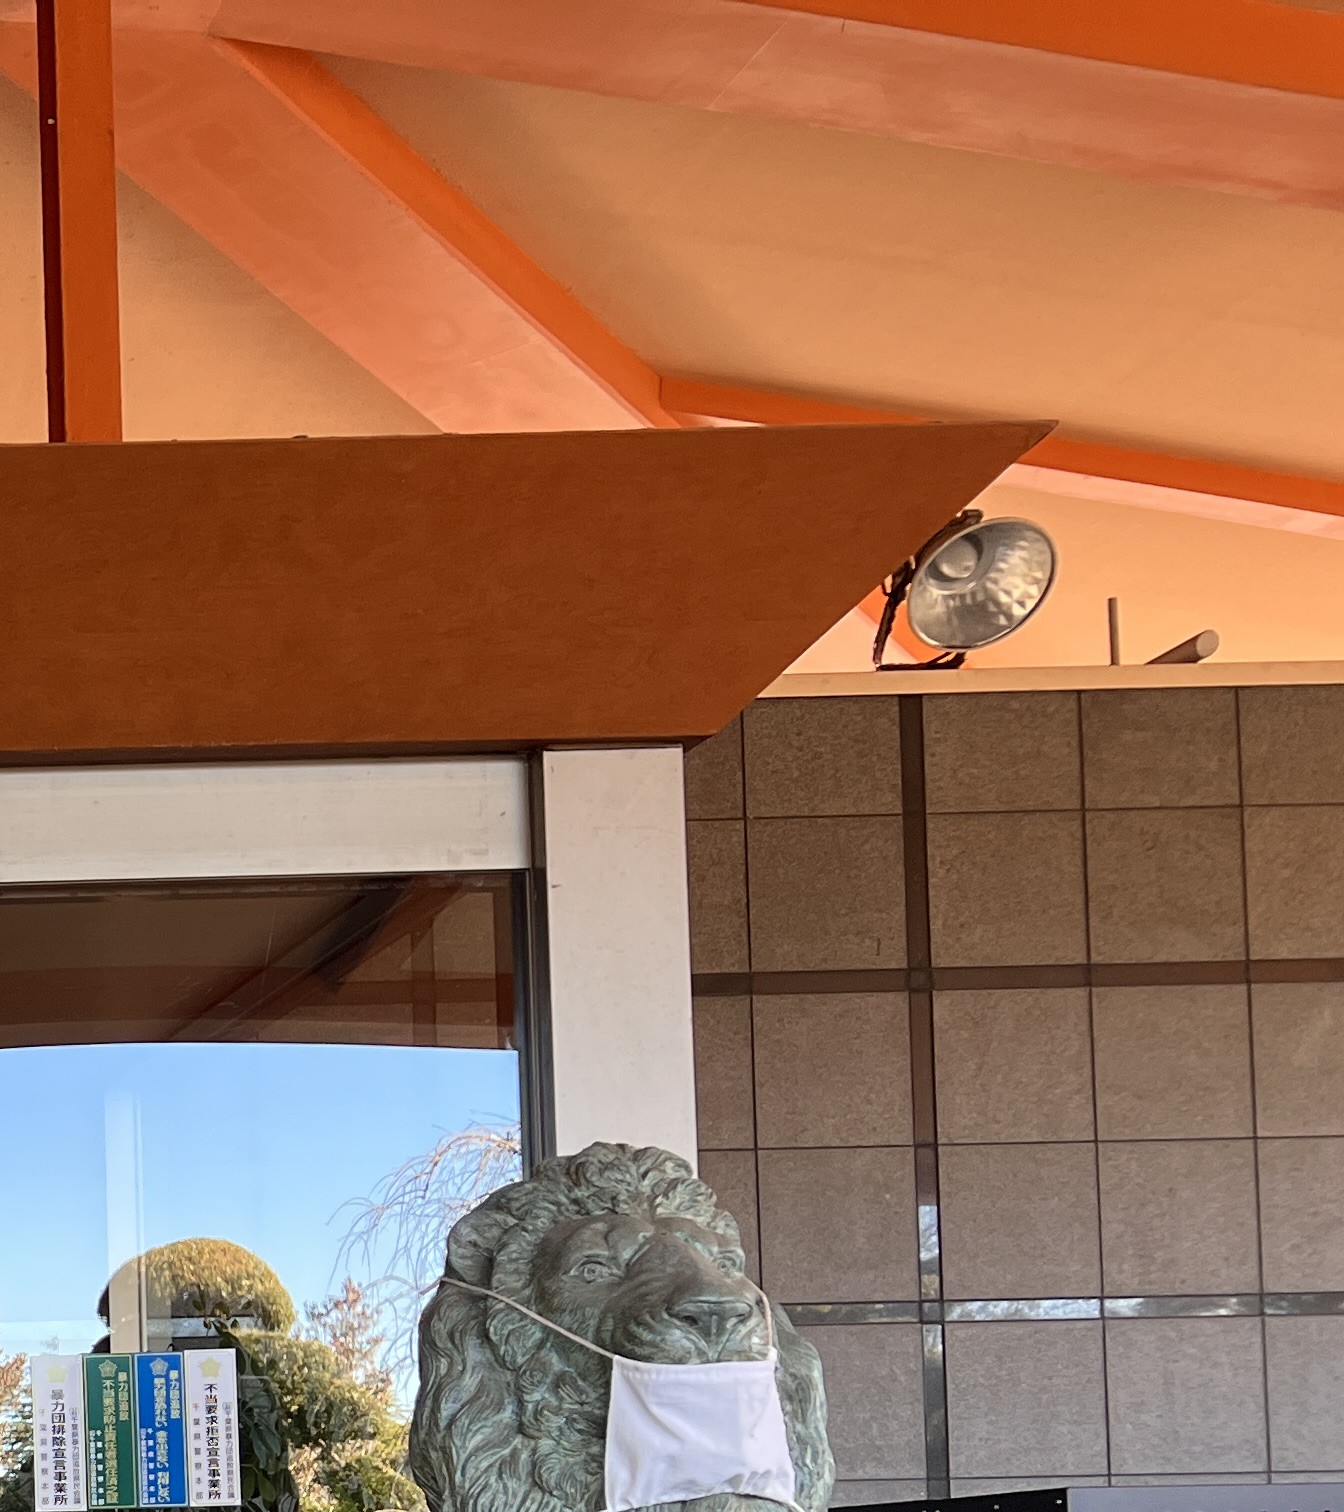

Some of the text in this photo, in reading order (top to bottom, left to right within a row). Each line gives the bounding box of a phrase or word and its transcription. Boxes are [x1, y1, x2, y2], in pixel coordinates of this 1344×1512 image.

[51, 1389, 68, 1506] 暴力団排除宣言事業所
[204, 1383, 221, 1500] 不当要求拒否宣言事業所
